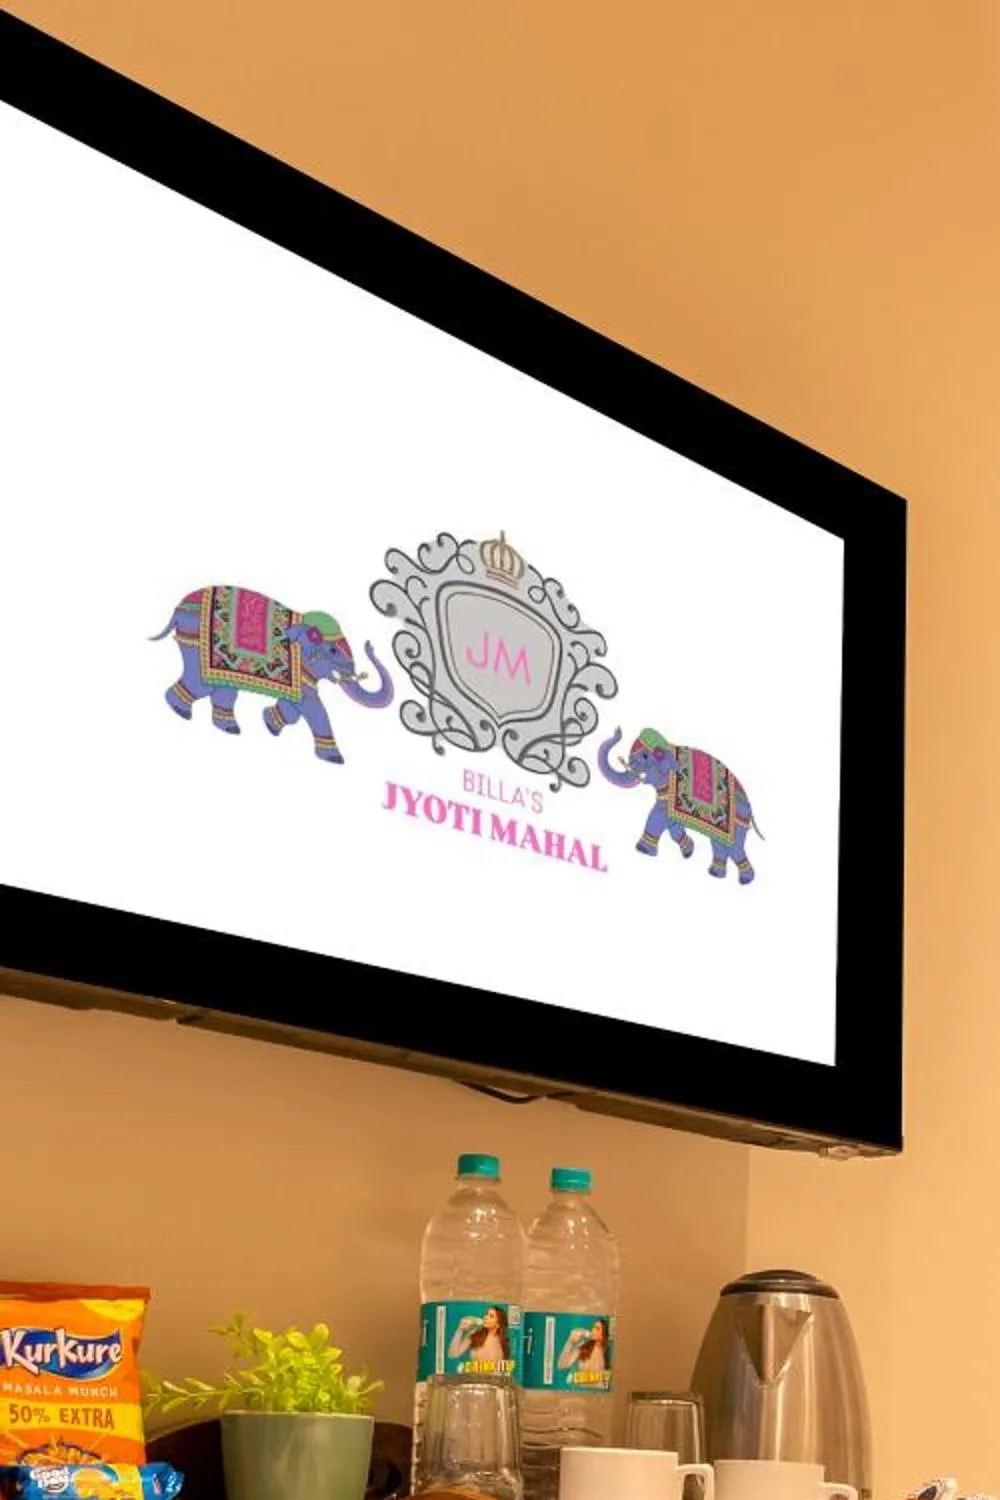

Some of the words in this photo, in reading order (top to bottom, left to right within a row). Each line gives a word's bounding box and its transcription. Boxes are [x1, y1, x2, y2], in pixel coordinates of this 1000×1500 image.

[465, 631, 532, 687] JM
[463, 767, 544, 815] BILLA'S
[382, 780, 483, 838] JYOTI
[489, 813, 609, 873] MAHAL
[2, 1327, 123, 1376] Kurkure
[2, 1382, 62, 1396] MASALA
[67, 1386, 118, 1398] MUNCH
[9, 1403, 51, 1425] 50%
[59, 1407, 116, 1430] EXTRA
